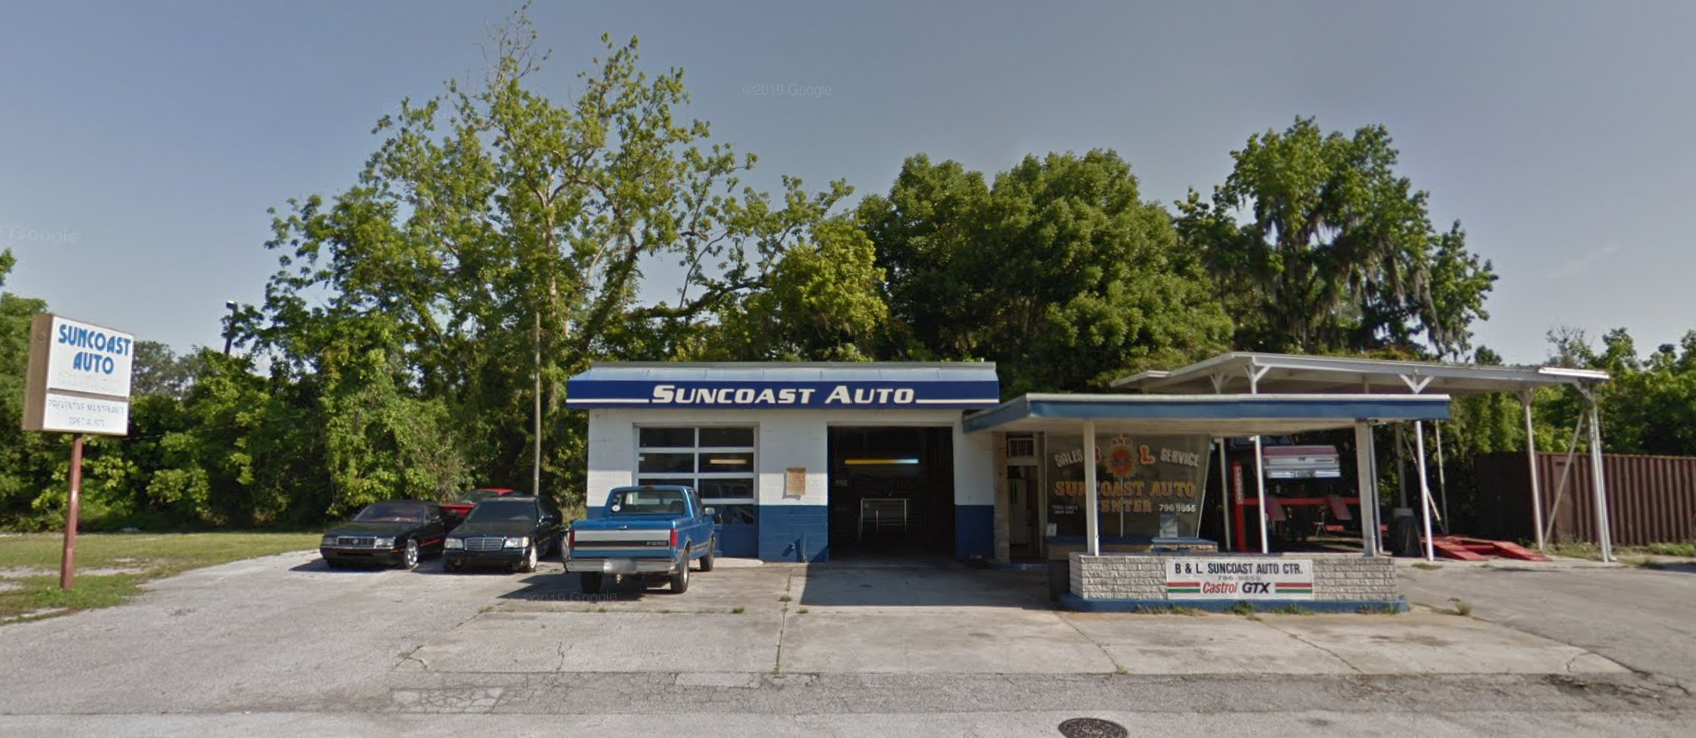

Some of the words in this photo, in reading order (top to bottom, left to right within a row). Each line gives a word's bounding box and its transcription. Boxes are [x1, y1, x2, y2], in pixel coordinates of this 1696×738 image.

[58, 324, 131, 356] SUNCOAST
[72, 351, 114, 375] AUTO
[1054, 449, 1083, 468] SALES
[1160, 447, 1200, 467] SERVICE
[1054, 480, 1145, 497] SUNOAST
[1149, 480, 1196, 498] AUTO
[1096, 498, 1152, 513] ENTER
[1175, 563, 1181, 574] B
[1185, 563, 1192, 574] &
[1196, 563, 1203, 574] L
[1207, 563, 1253, 574] SUNCOAST
[1256, 563, 1279, 574] AUTO
[1283, 563, 1303, 574] CTR.
[1202, 581, 1238, 594] Castrol
[1242, 582, 1271, 594] GTX
